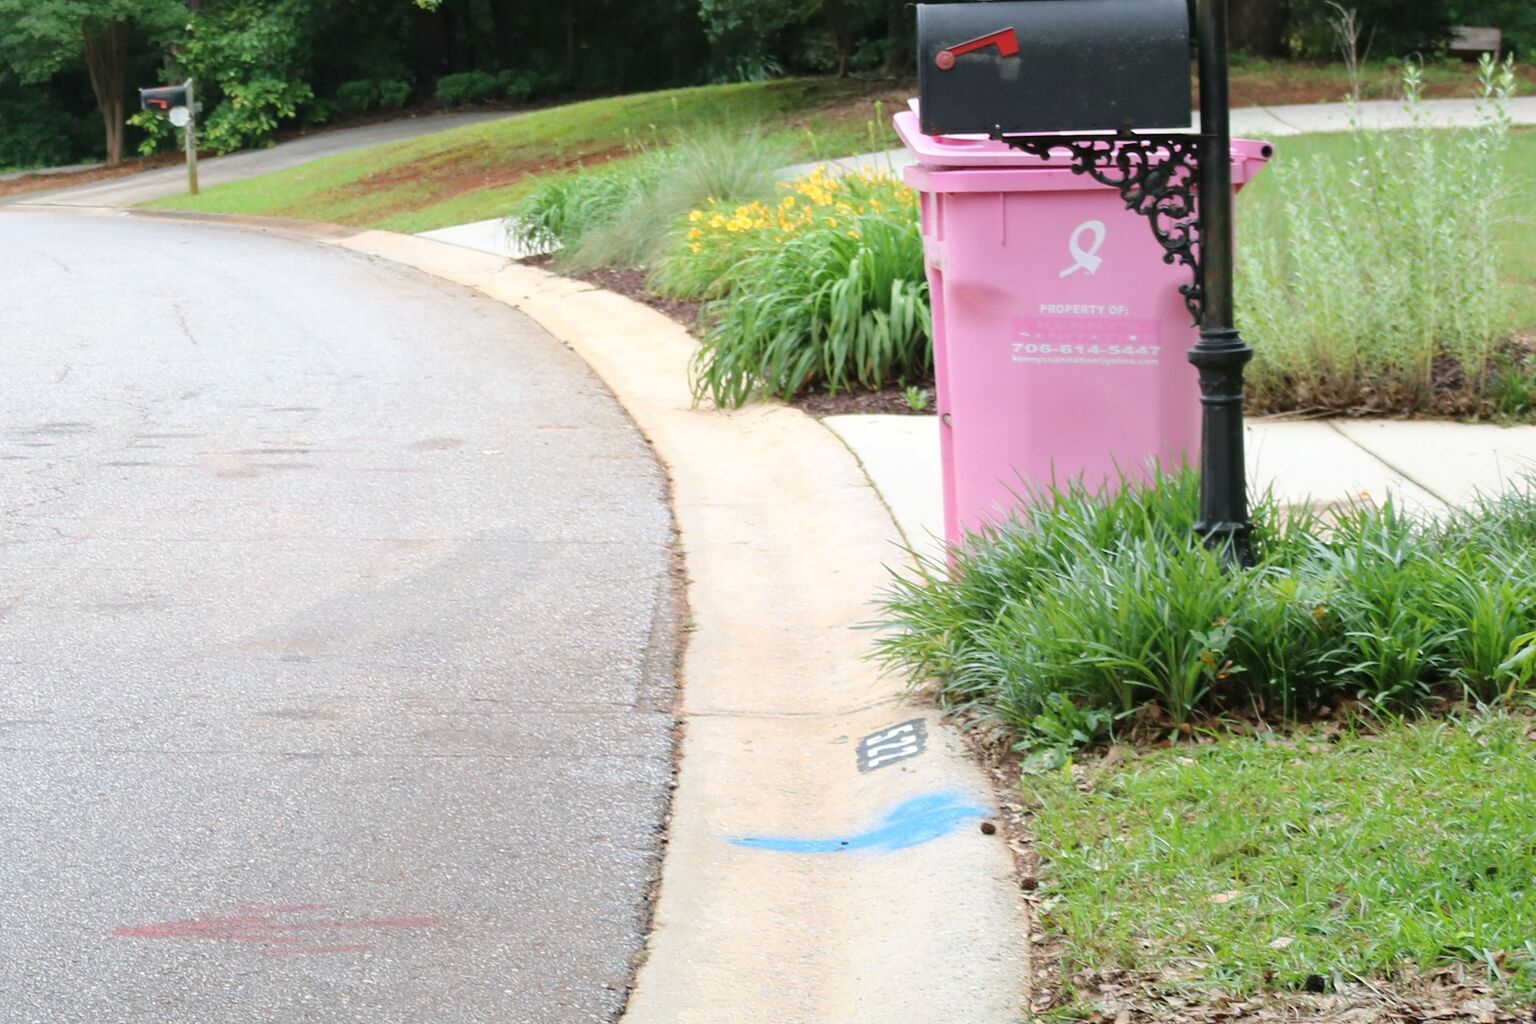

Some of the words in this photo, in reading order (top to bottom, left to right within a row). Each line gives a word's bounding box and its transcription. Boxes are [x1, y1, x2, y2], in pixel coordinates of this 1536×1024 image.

[1039, 304, 1105, 315] PROPERTY
[1108, 305, 1129, 316] OF:
[1011, 343, 1161, 355] 706-614-5447
[866, 724, 919, 768] 522
